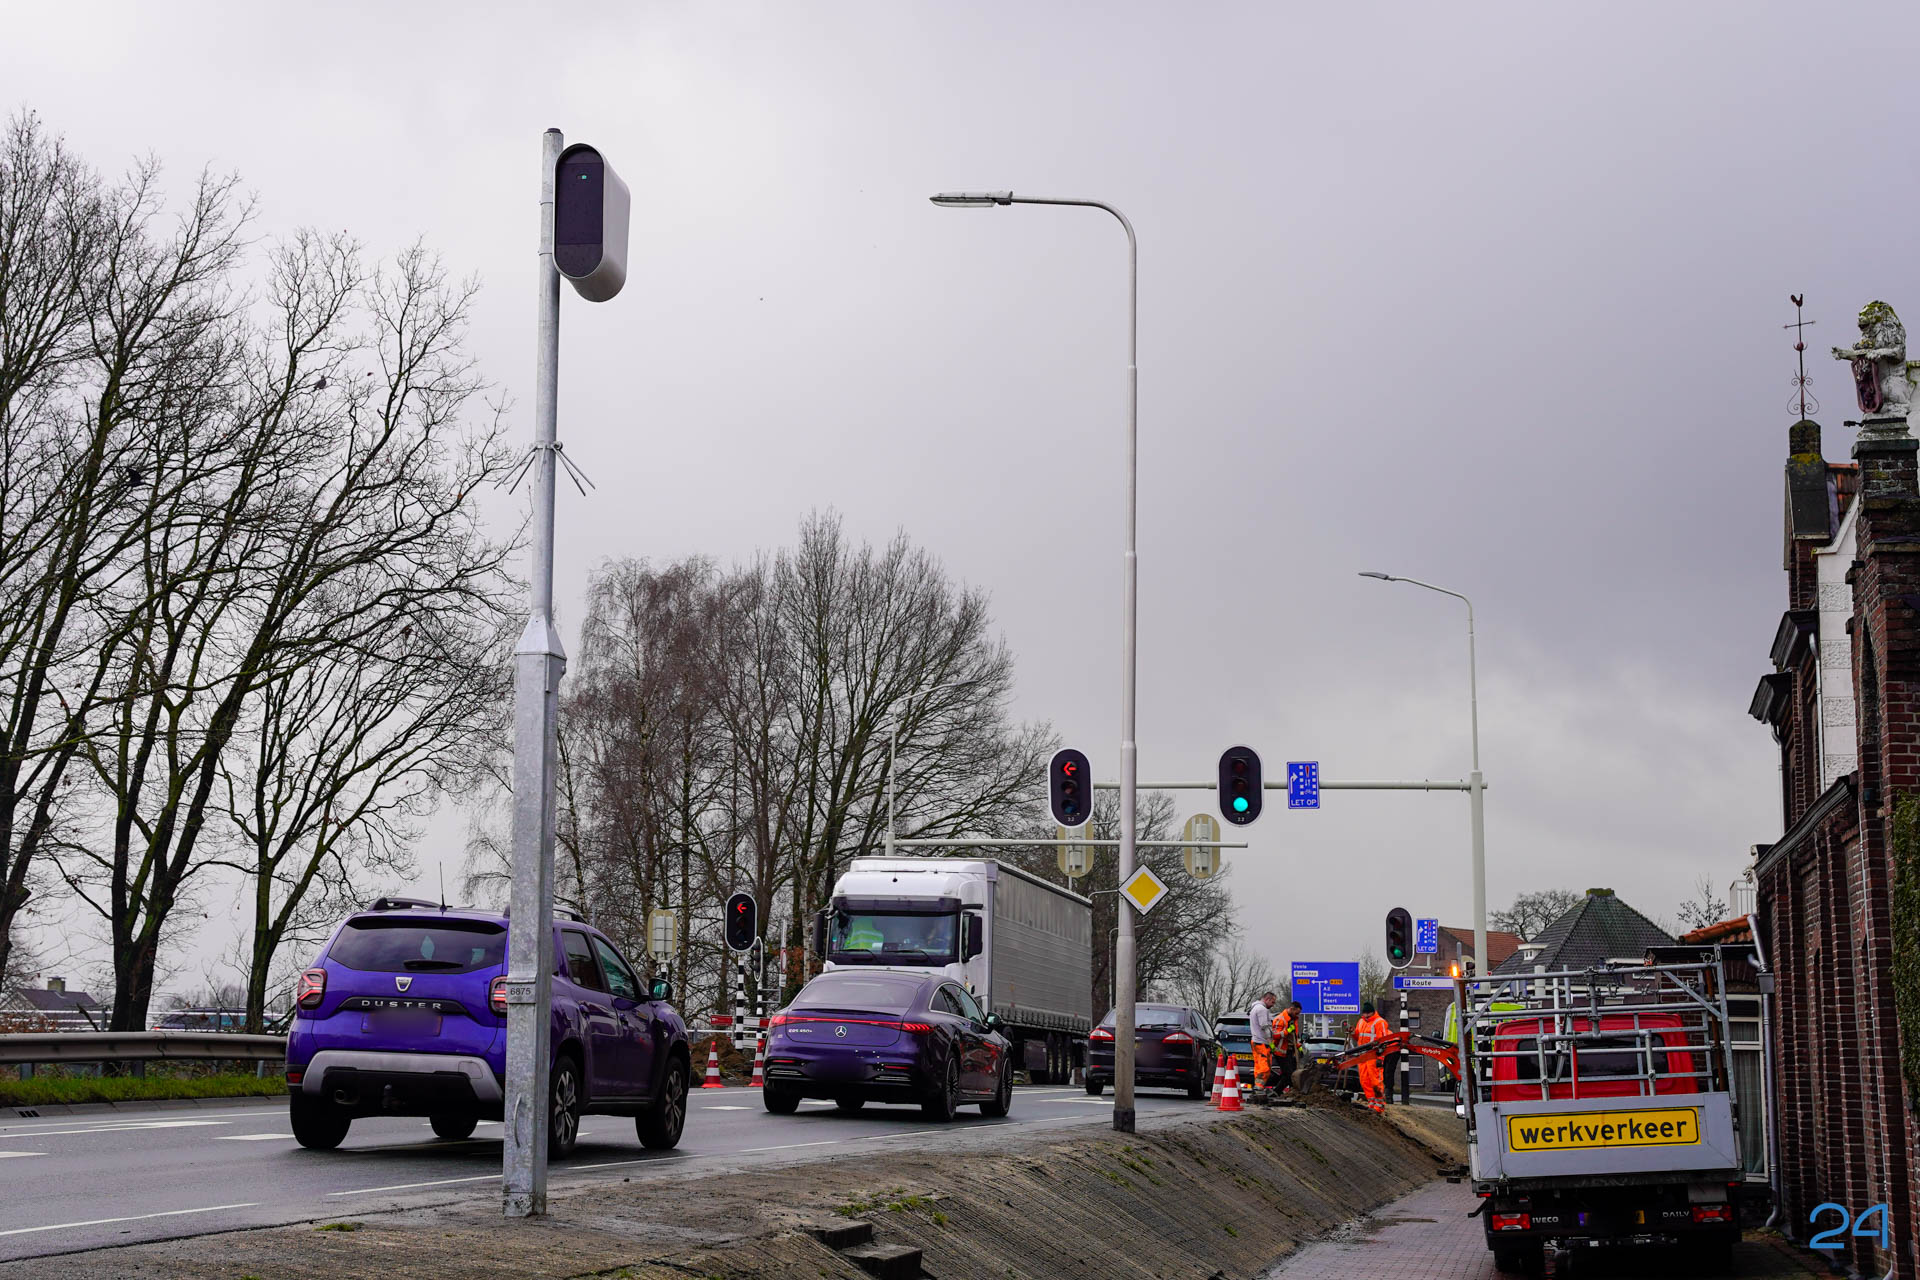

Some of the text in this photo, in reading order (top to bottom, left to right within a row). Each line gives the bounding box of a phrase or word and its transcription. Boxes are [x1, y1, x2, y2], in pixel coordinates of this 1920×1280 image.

[510, 987, 531, 995] 6875
[361, 999, 441, 1009] DUSTER
[1520, 1118, 1687, 1144] werkverkeer
[1662, 1210, 1690, 1218] DAILY
[1532, 1216, 1559, 1224] IVECO
